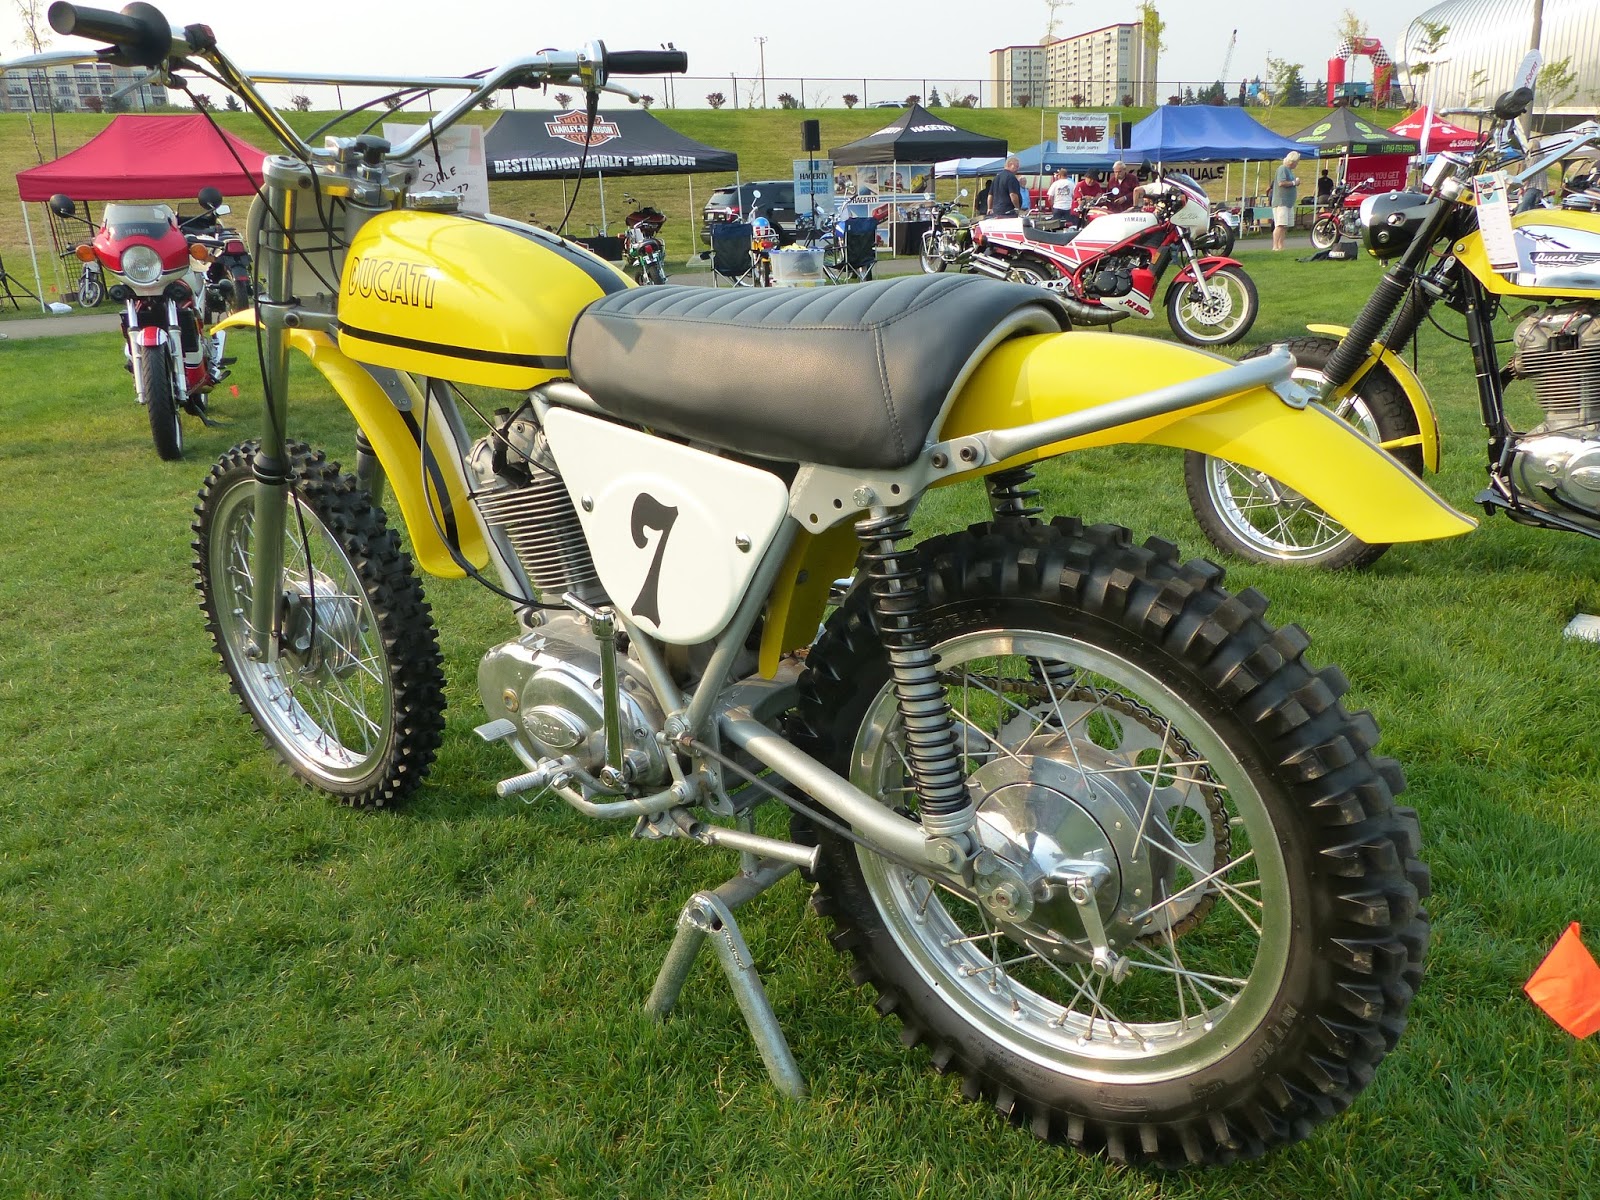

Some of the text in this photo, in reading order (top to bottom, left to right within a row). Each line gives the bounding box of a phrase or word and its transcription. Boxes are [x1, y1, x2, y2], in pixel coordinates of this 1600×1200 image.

[552, 124, 614, 134] HARLEY-DAIDSON
[909, 123, 957, 133] HAGERTY
[494, 153, 696, 174] DESTINATION HARLEY-DAVIDSON
[422, 166, 457, 191] SALE
[1162, 166, 1226, 181] MNUALS
[1535, 252, 1579, 262] Ducati
[348, 256, 439, 309] DUCATI
[630, 492, 679, 630] 7
